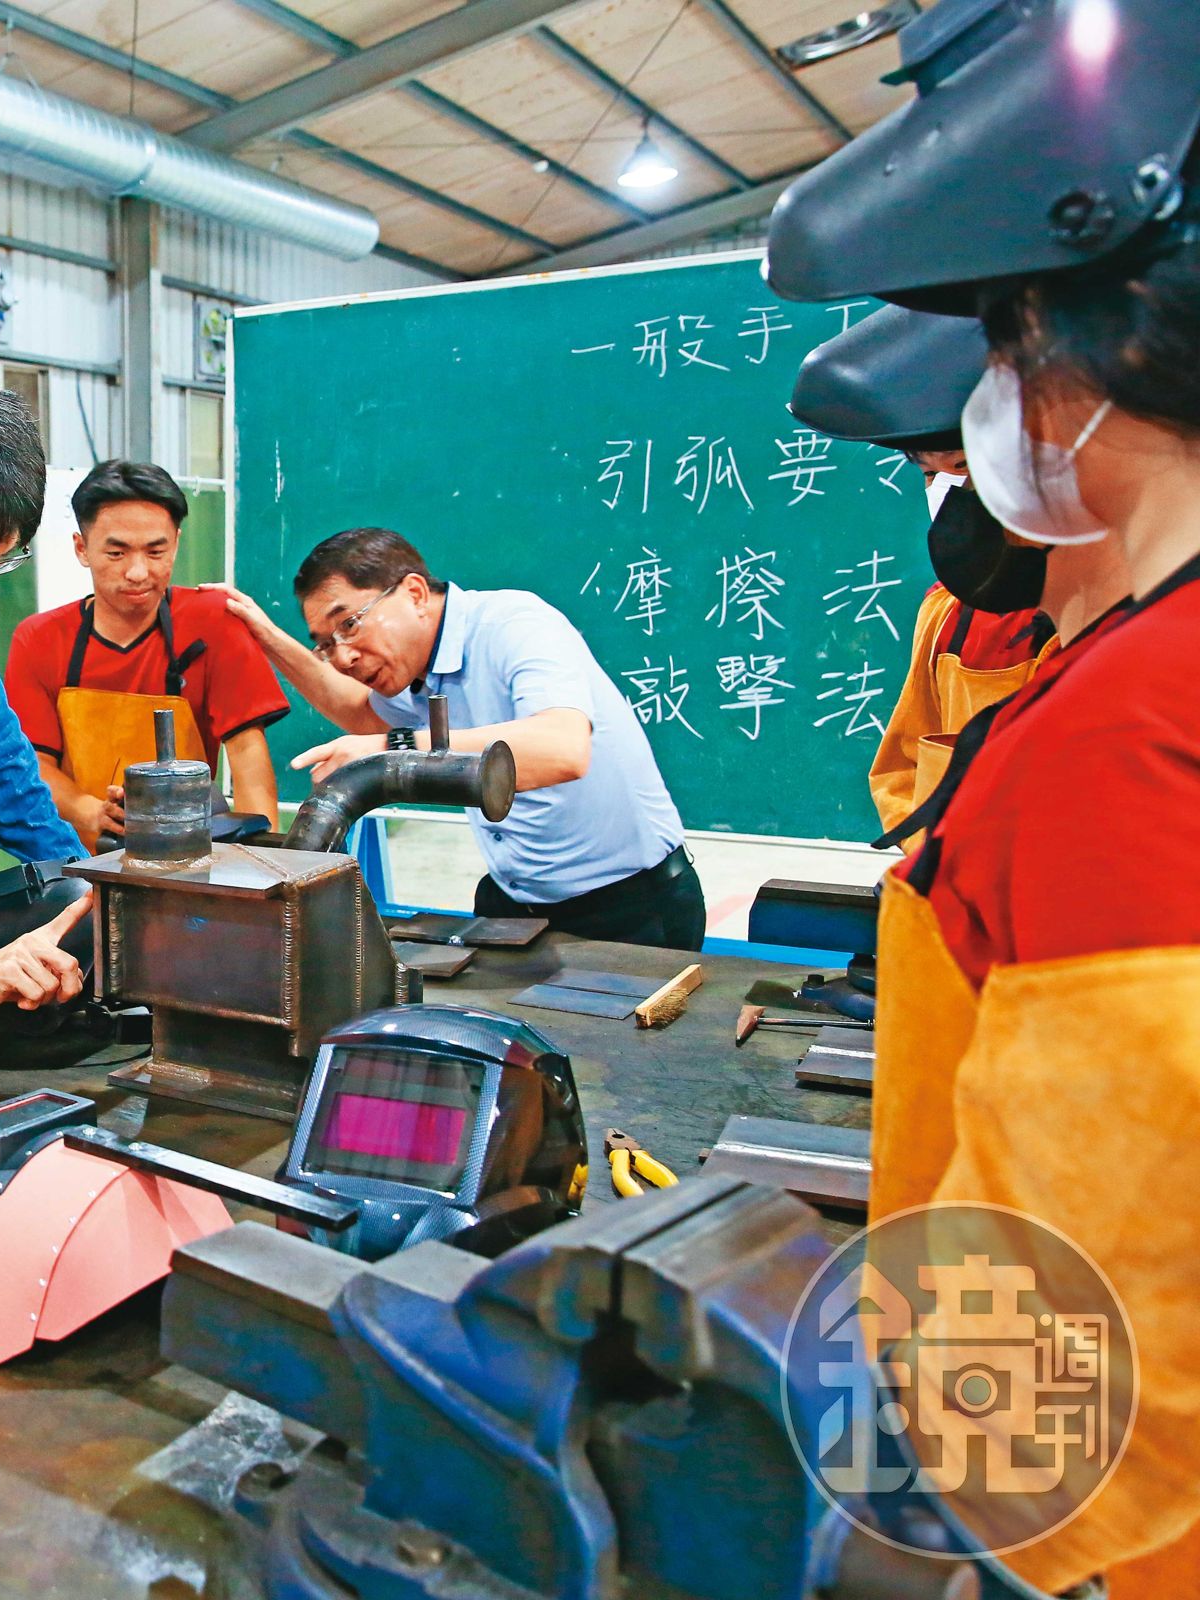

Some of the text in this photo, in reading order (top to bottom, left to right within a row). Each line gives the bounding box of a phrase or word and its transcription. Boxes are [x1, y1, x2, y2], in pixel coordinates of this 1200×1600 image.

[613, 546, 902, 641] 摩擦法
[620, 653, 888, 740] 敲擊法
